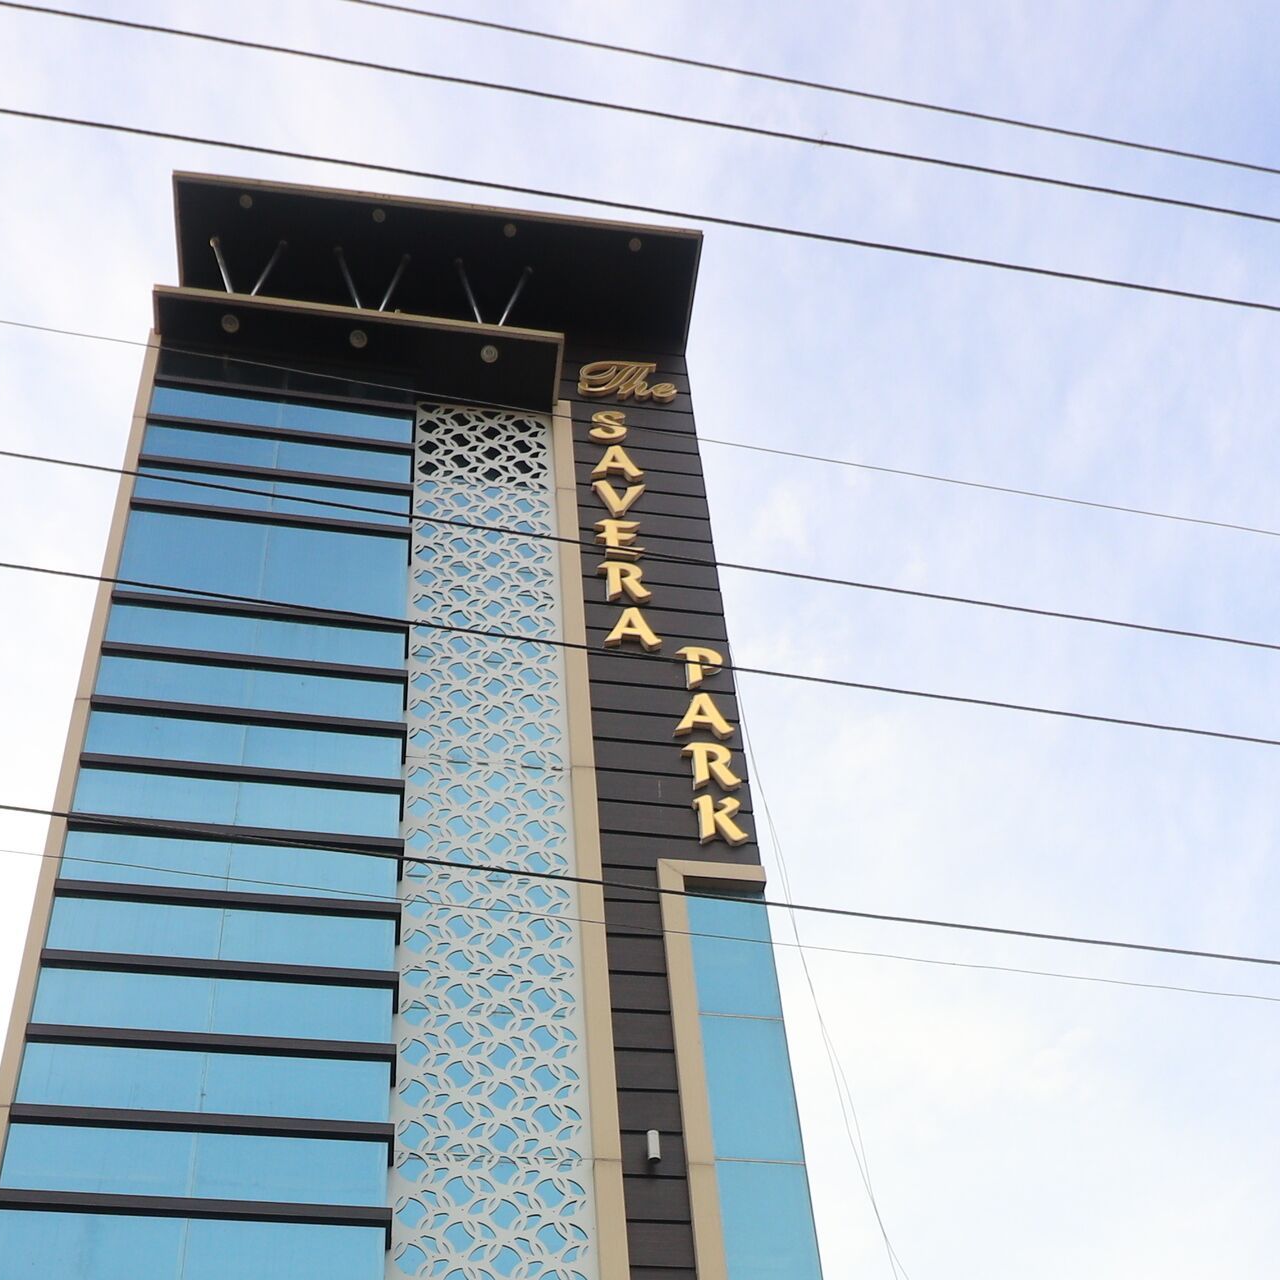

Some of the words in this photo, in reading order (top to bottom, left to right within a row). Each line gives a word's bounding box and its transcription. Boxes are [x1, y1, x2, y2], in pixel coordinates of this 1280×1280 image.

[577, 360, 678, 403] The
[589, 410, 662, 652] SAVERA
[673, 646, 749, 847] PARK
